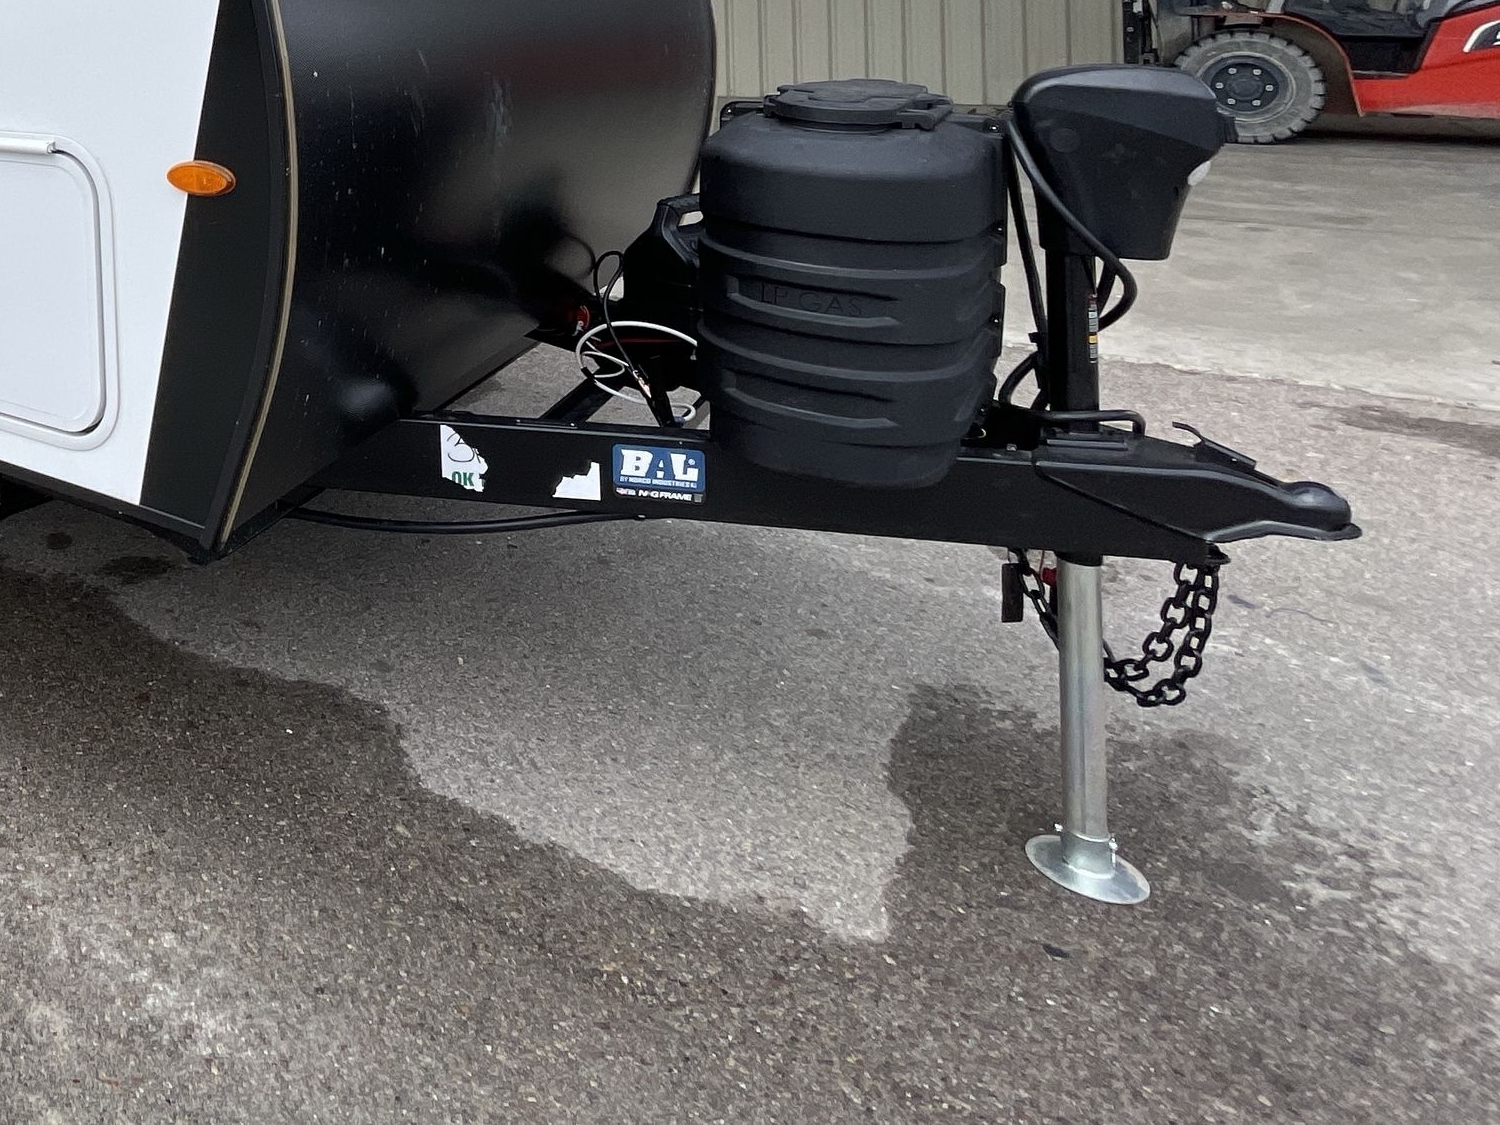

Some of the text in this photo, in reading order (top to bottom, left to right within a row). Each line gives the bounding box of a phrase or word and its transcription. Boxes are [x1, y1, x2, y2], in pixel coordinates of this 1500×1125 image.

[761, 282, 862, 316] LP GAS
[451, 471, 475, 487] OK
[620, 449, 699, 481] BAL
